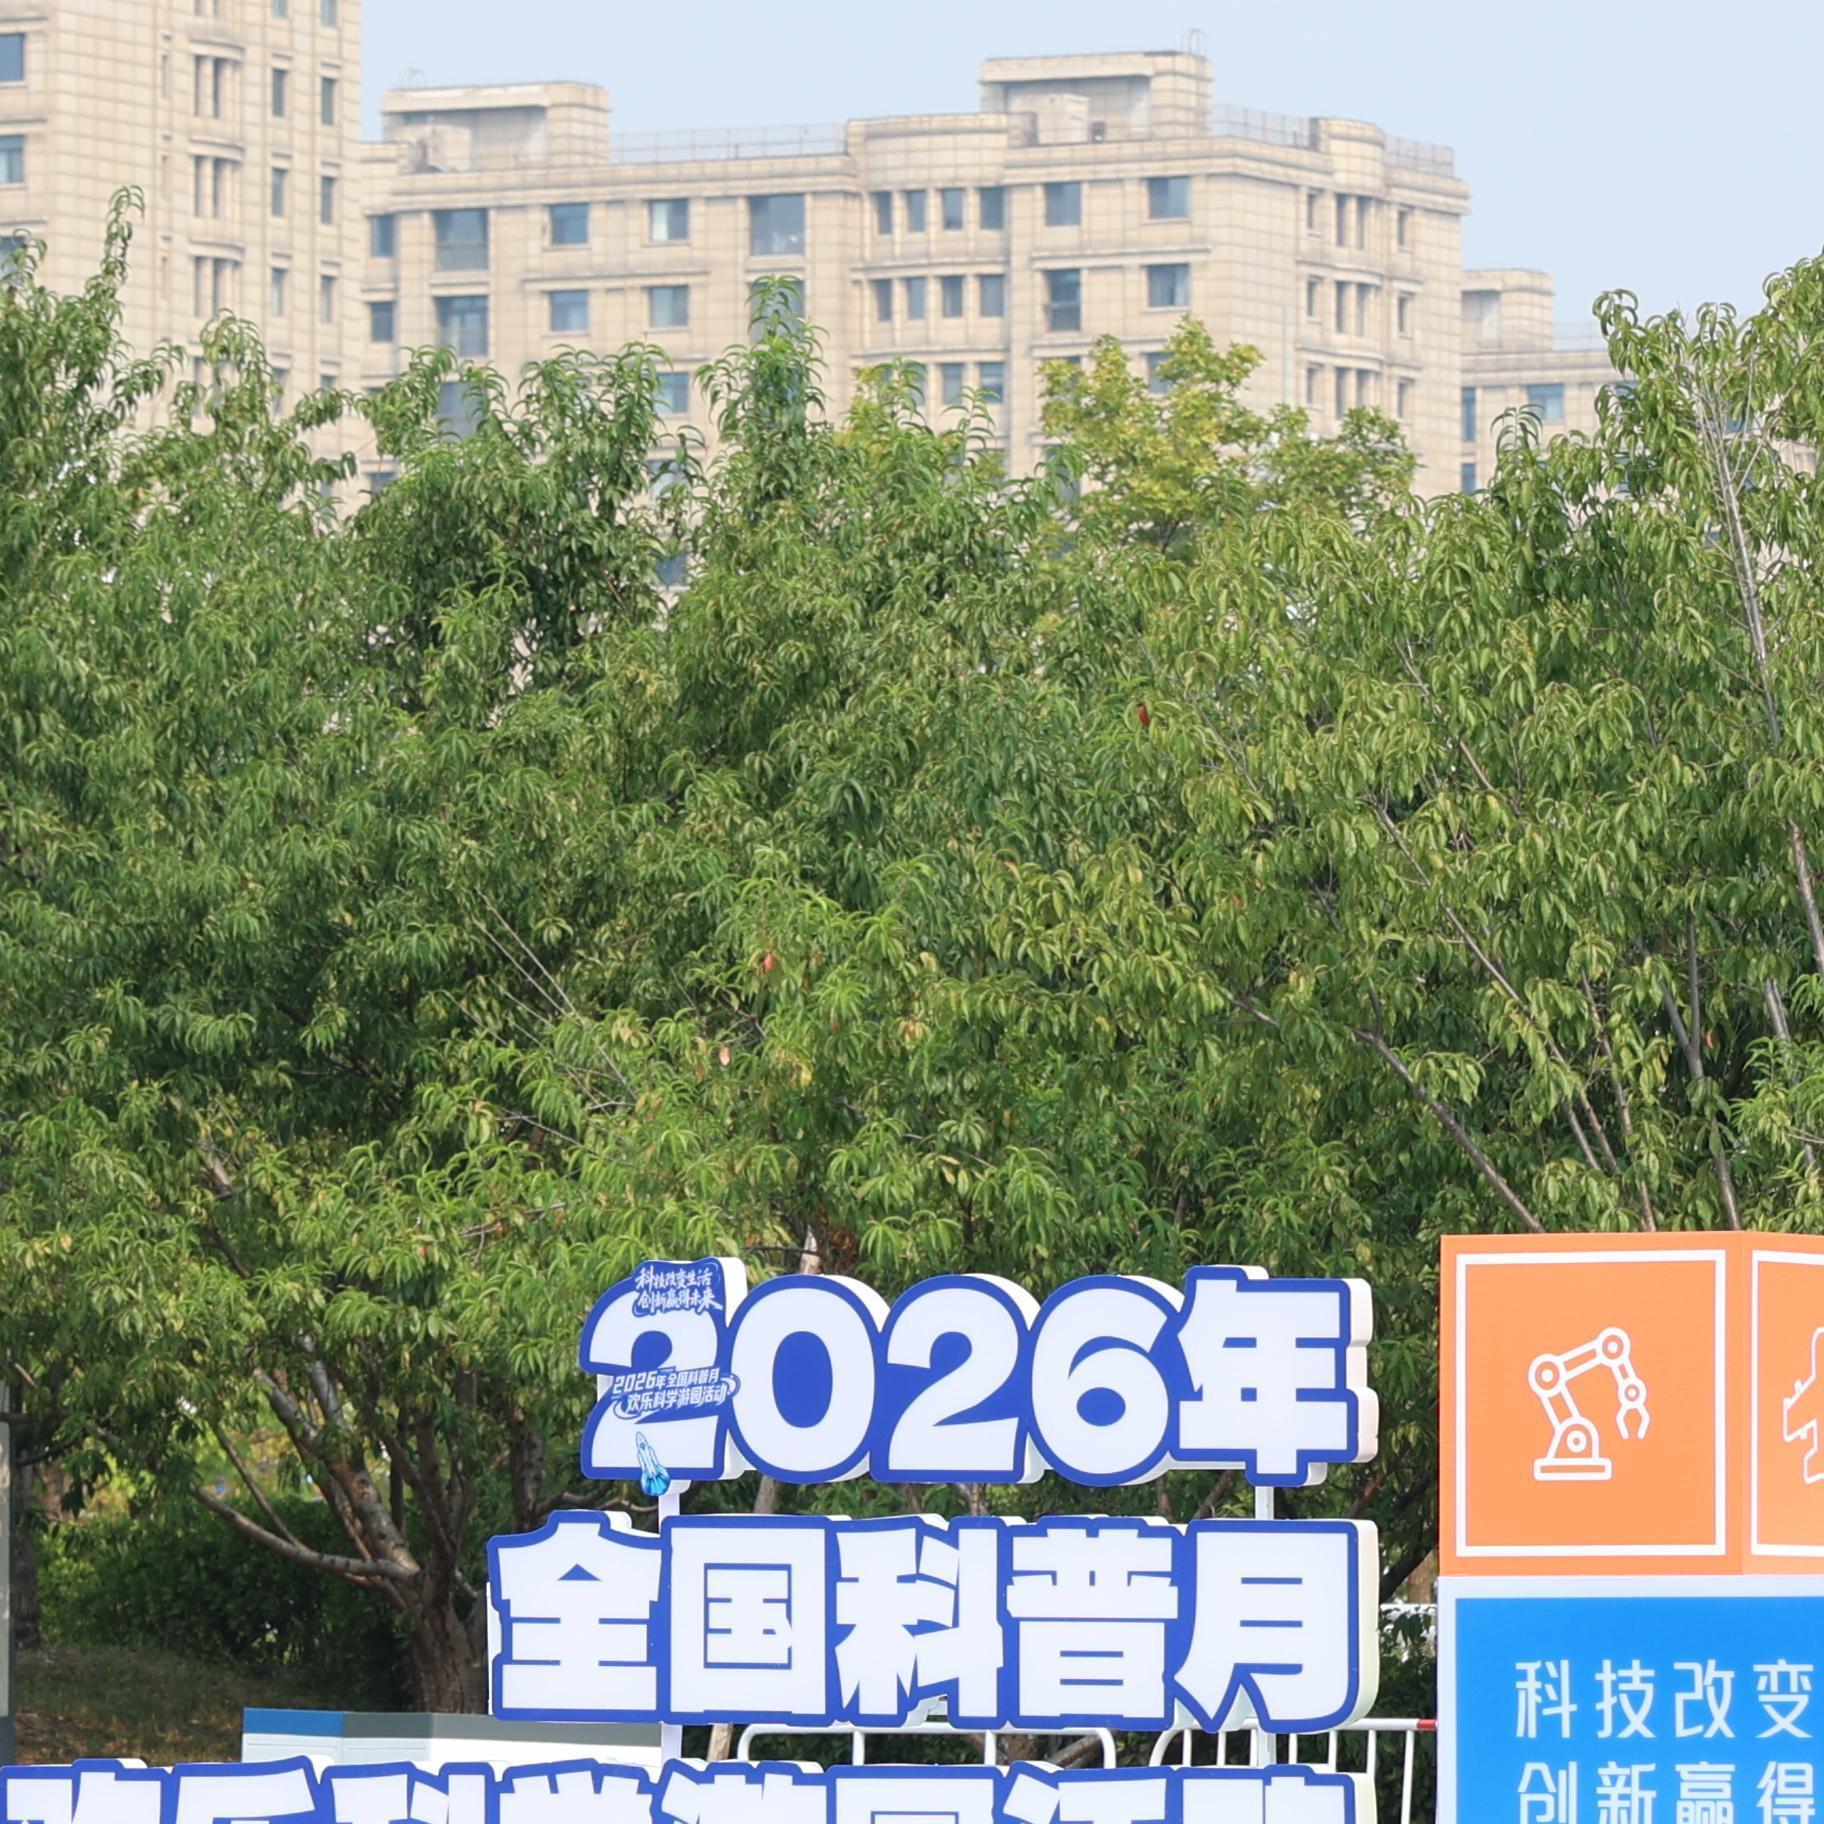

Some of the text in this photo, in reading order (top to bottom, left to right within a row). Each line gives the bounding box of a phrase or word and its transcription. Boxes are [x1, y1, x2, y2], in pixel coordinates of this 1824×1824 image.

[636, 1265, 712, 1291] 科技改变生活
[639, 1288, 723, 1313] 创新赢得未来
[584, 1276, 1354, 1478] 2026年
[627, 1385, 727, 1412] 欢乐科学游园活动
[496, 1520, 1360, 1728] 全国科普月
